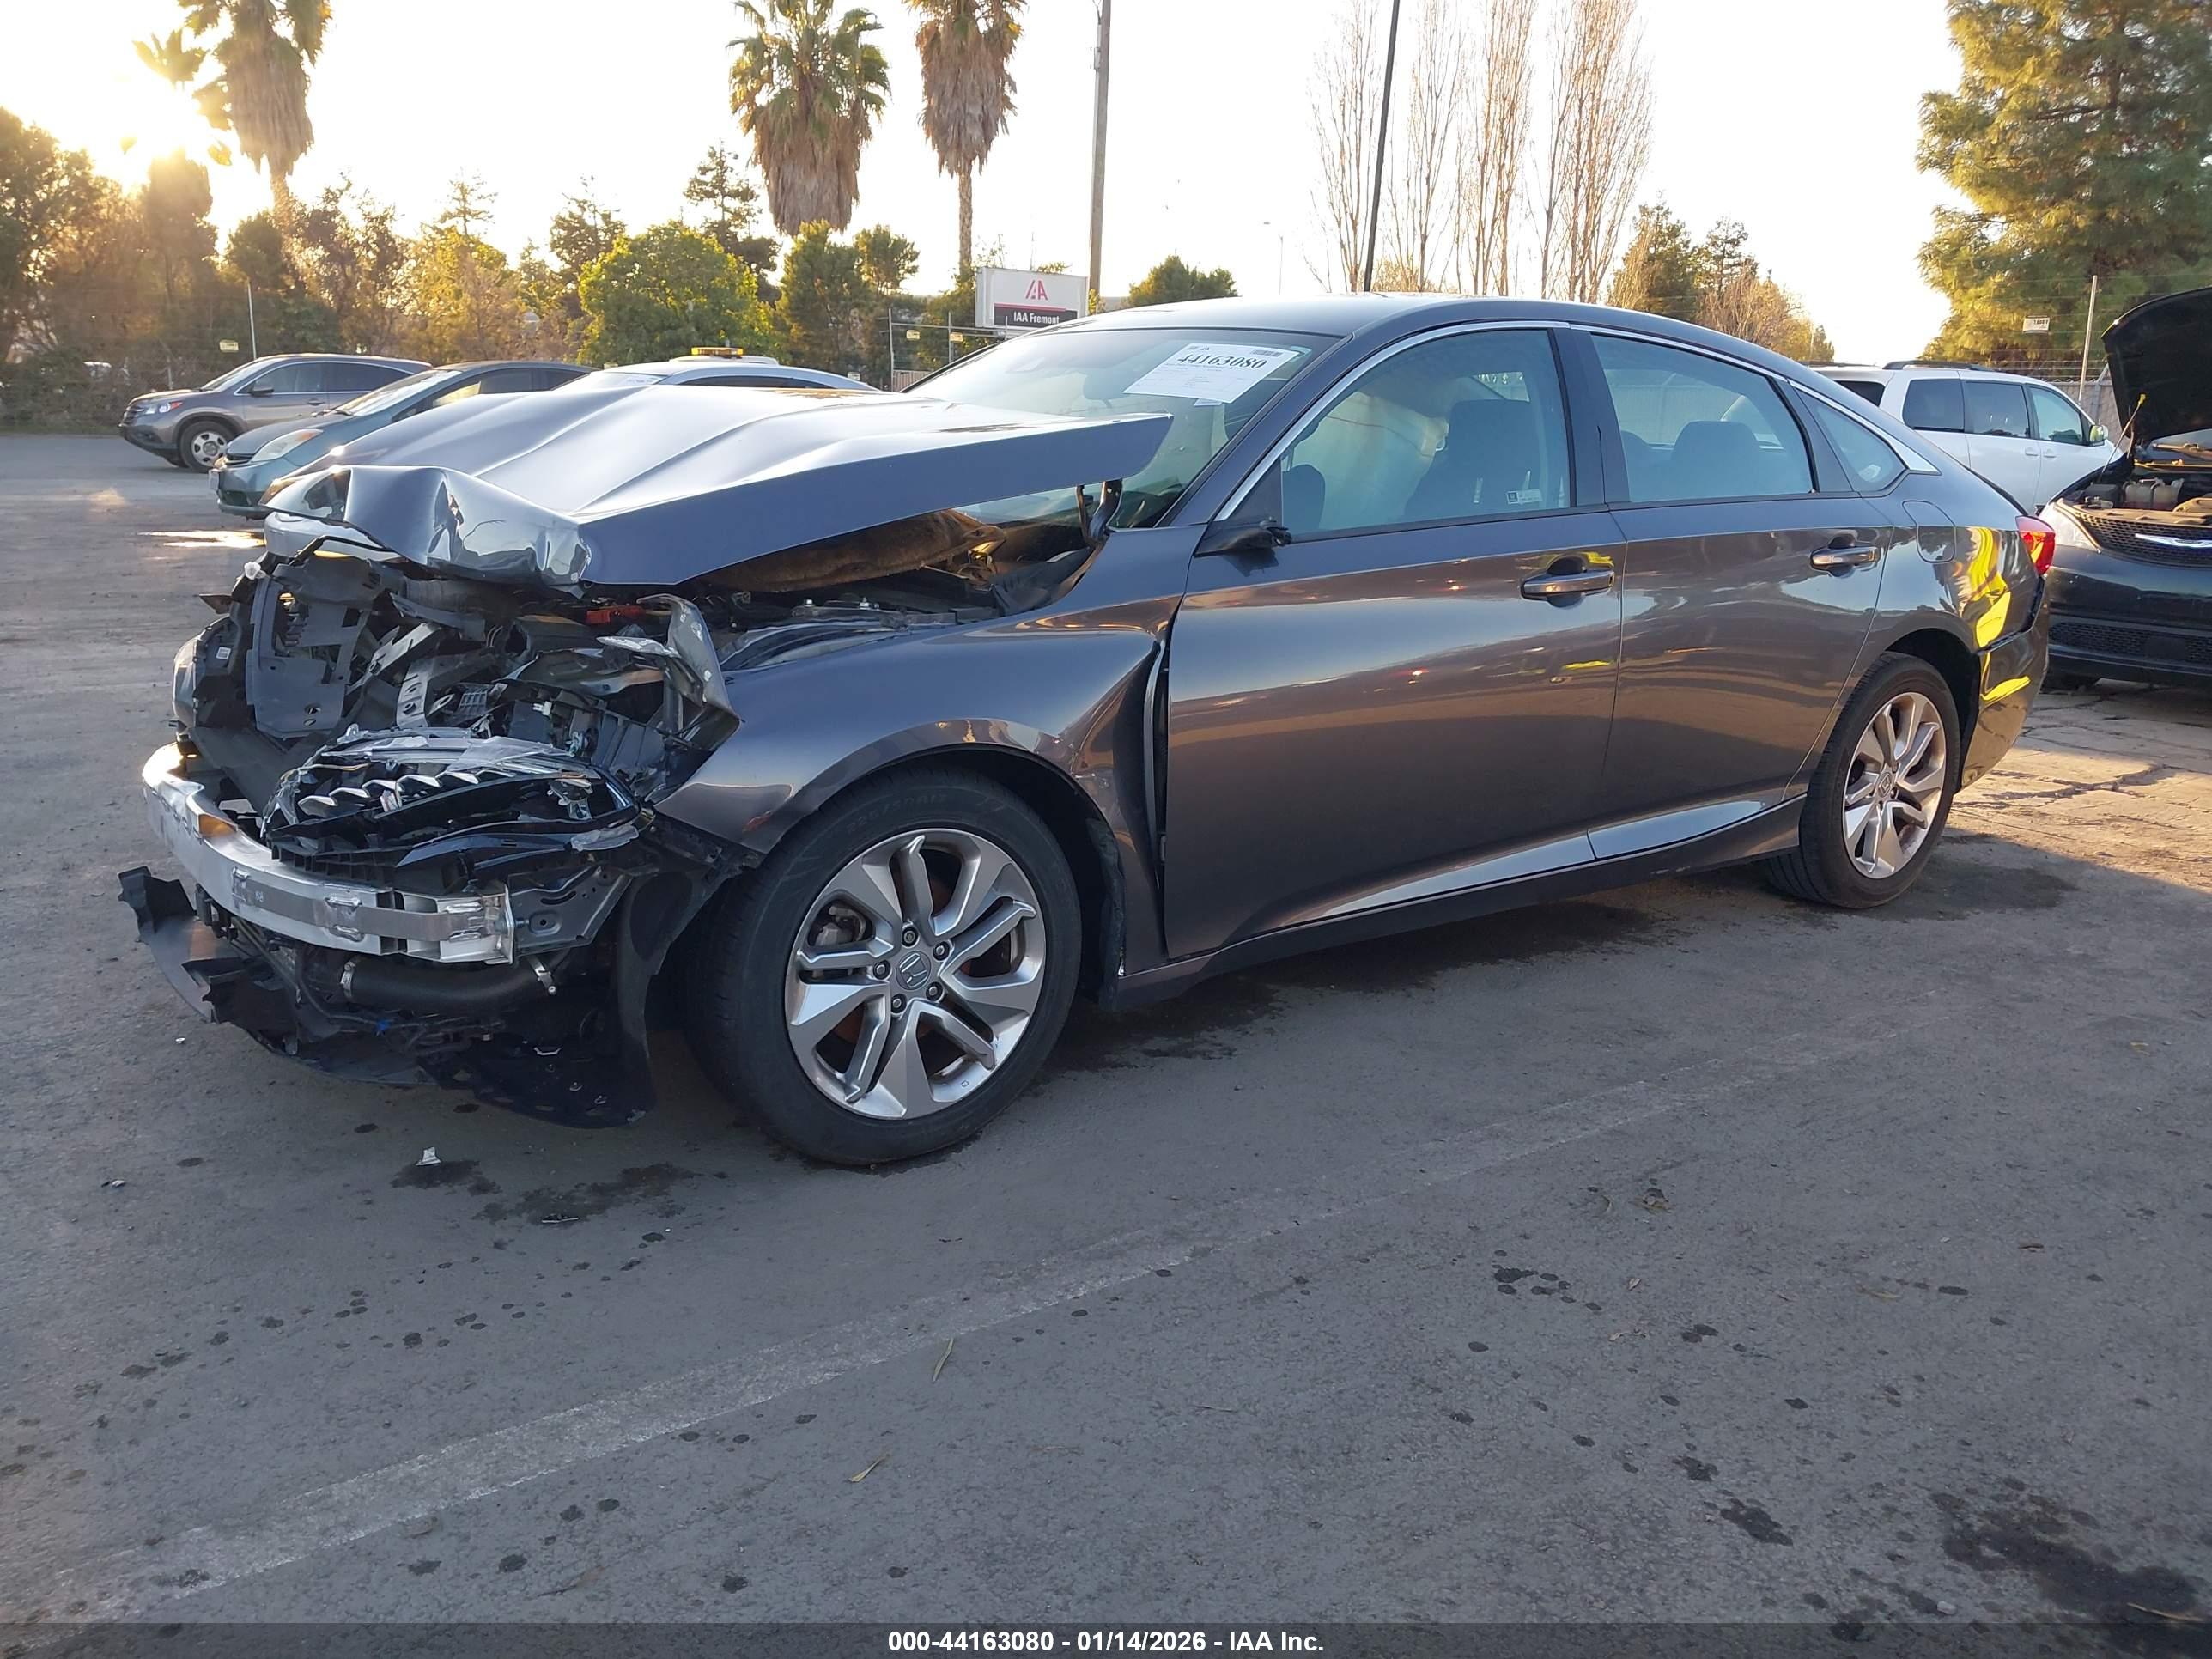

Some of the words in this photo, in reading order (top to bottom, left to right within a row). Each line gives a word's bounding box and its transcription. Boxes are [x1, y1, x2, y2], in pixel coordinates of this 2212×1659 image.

[1013, 311, 1029, 323] IAA
[1030, 313, 1060, 325] Fremont
[1177, 353, 1267, 369] 44163080
